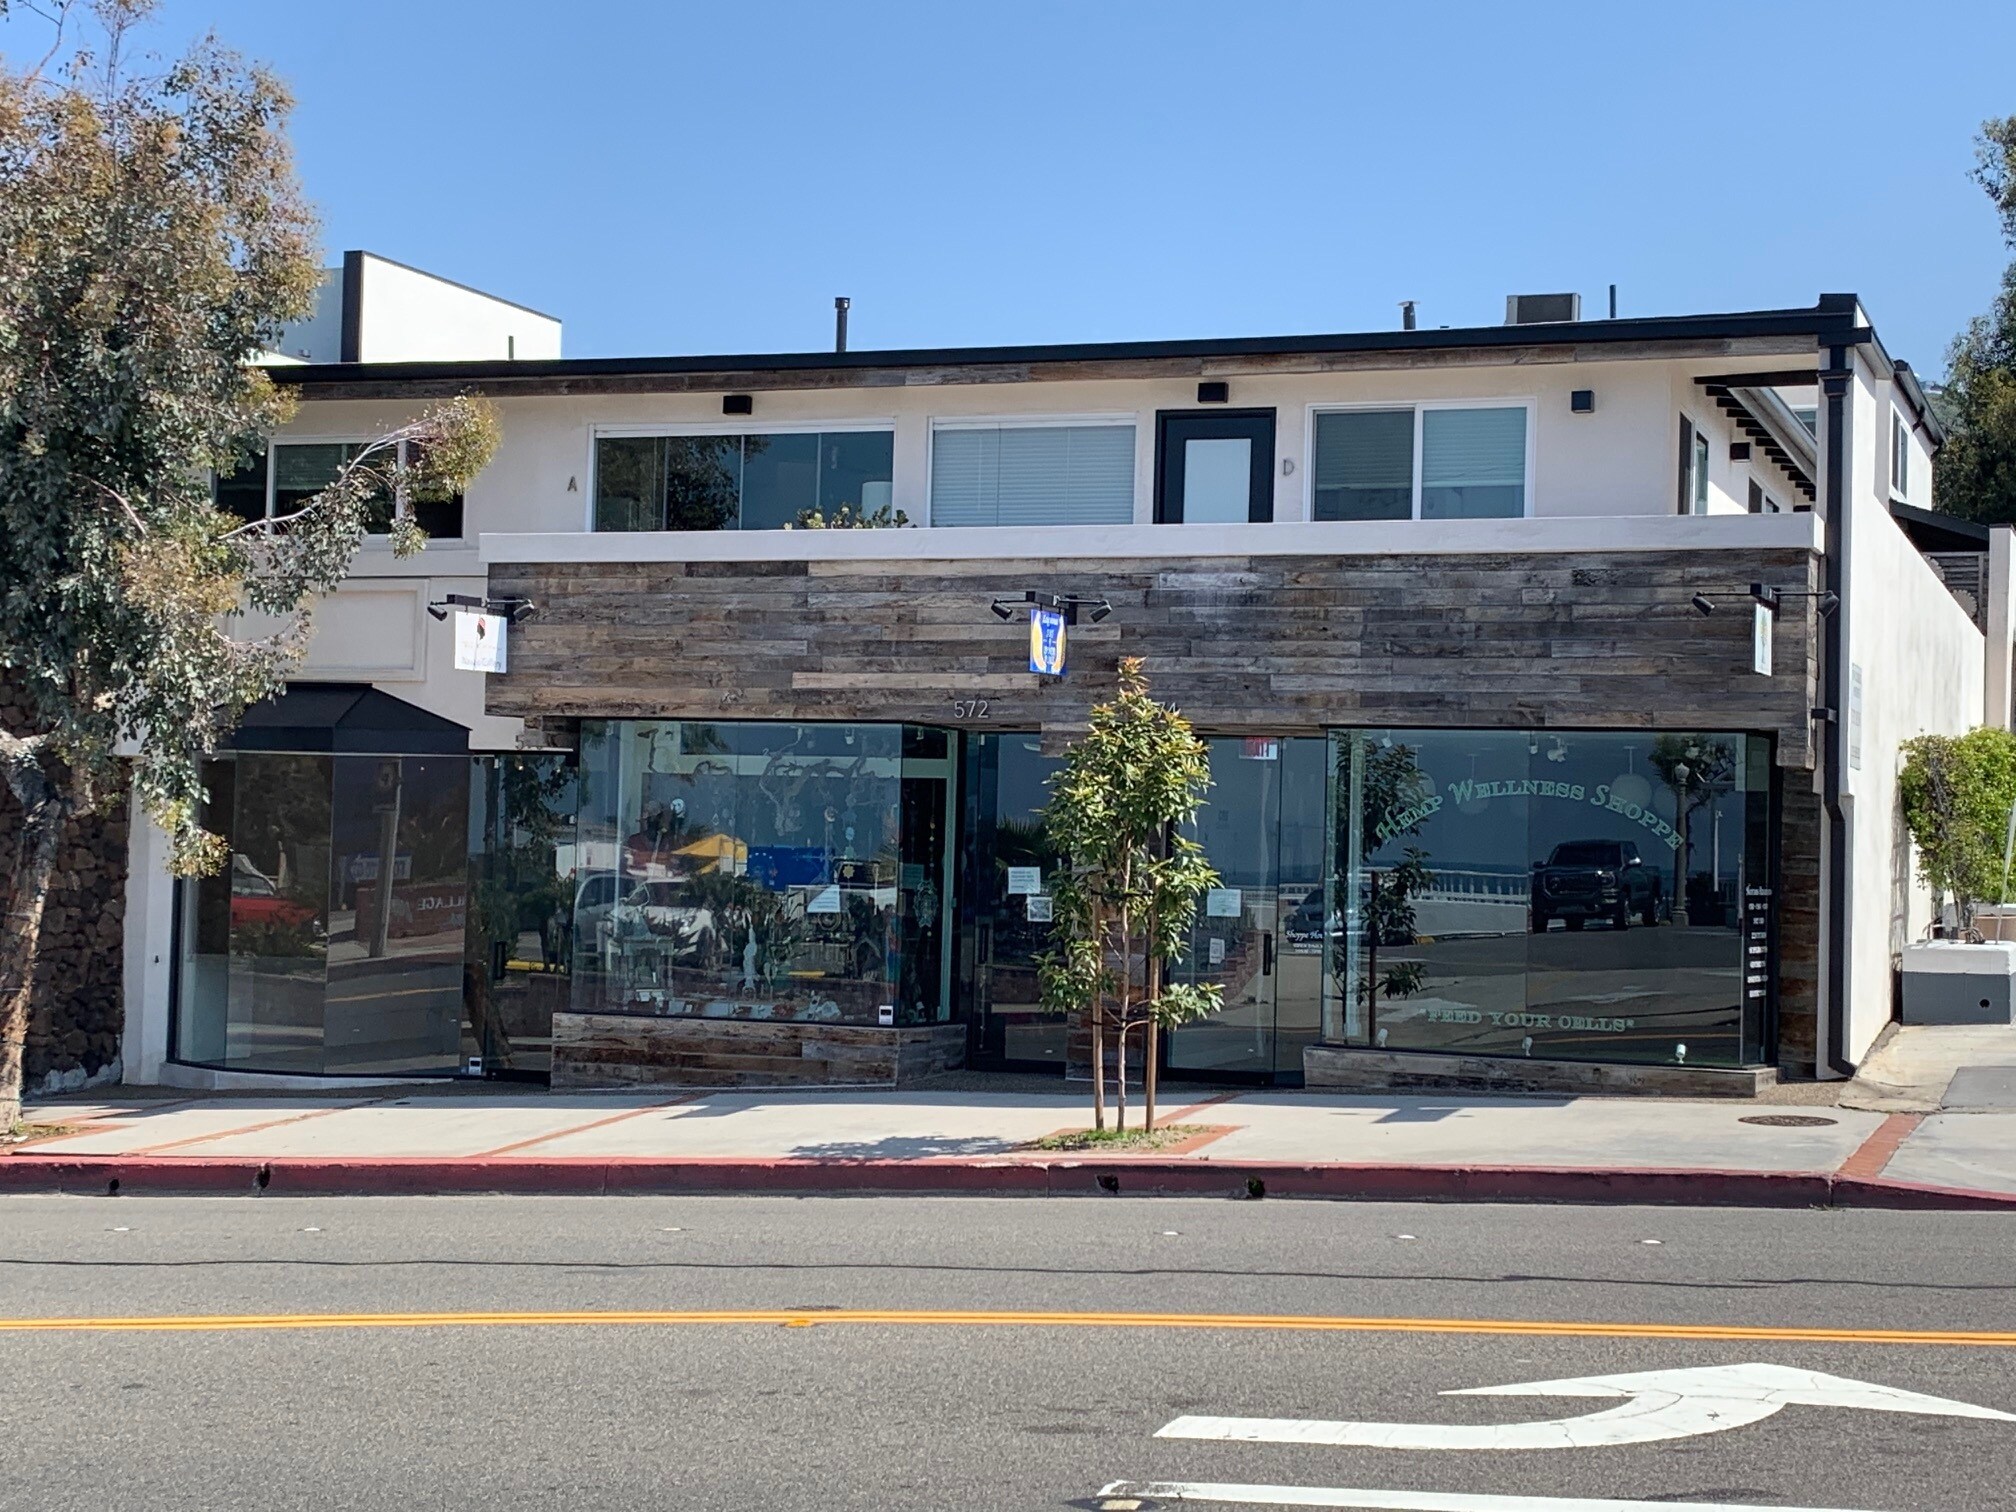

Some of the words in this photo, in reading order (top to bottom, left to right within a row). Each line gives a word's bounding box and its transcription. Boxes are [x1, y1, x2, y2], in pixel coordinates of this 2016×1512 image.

[1282, 458, 1295, 477] D
[567, 475, 578, 492] A
[953, 700, 990, 719] 572
[1447, 778, 1585, 804] WELLNESS
[1590, 784, 1684, 850] SHOPPE
[1488, 1011, 1552, 1028] YOUR
